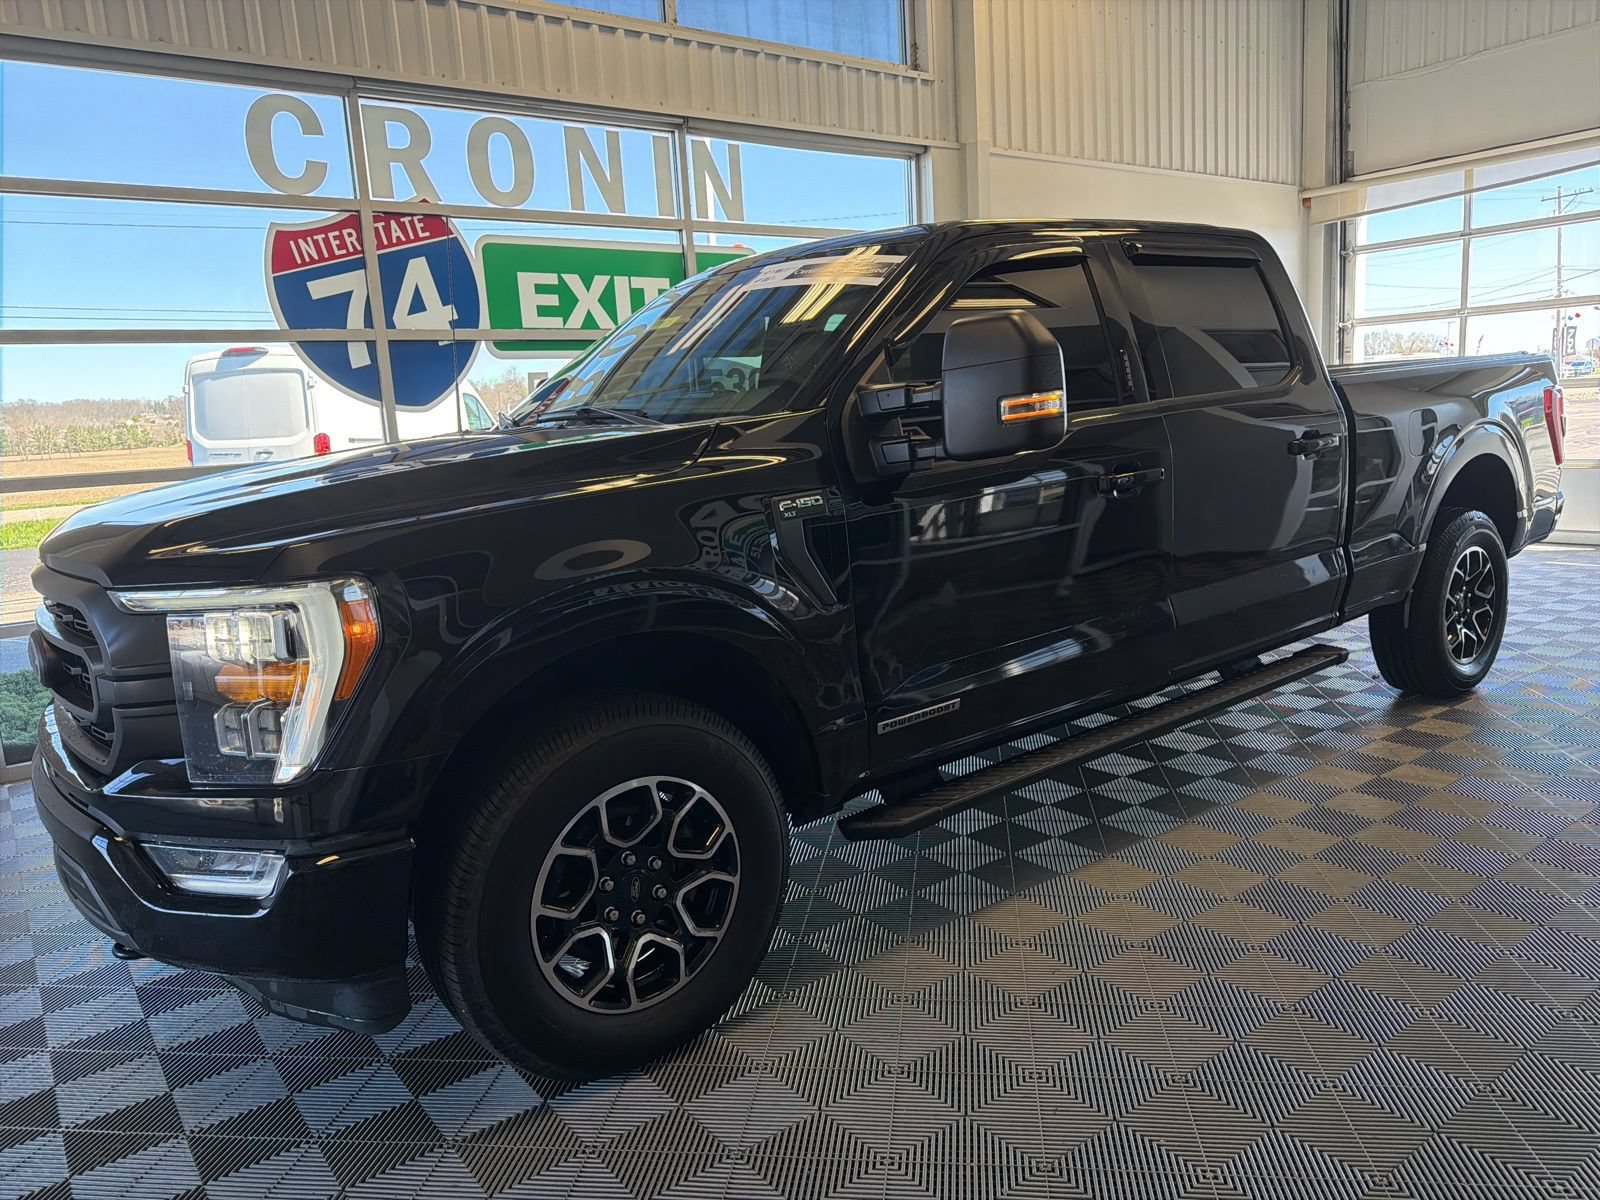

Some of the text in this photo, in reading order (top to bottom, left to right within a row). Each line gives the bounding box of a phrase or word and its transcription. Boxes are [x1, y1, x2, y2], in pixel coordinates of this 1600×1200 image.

[244, 93, 745, 222] CRONIN
[288, 214, 431, 265] INTERTATE
[305, 255, 459, 370] 74
[516, 271, 671, 330] EXIT
[779, 495, 824, 511] F-150
[881, 703, 957, 731] POWERBOOST
